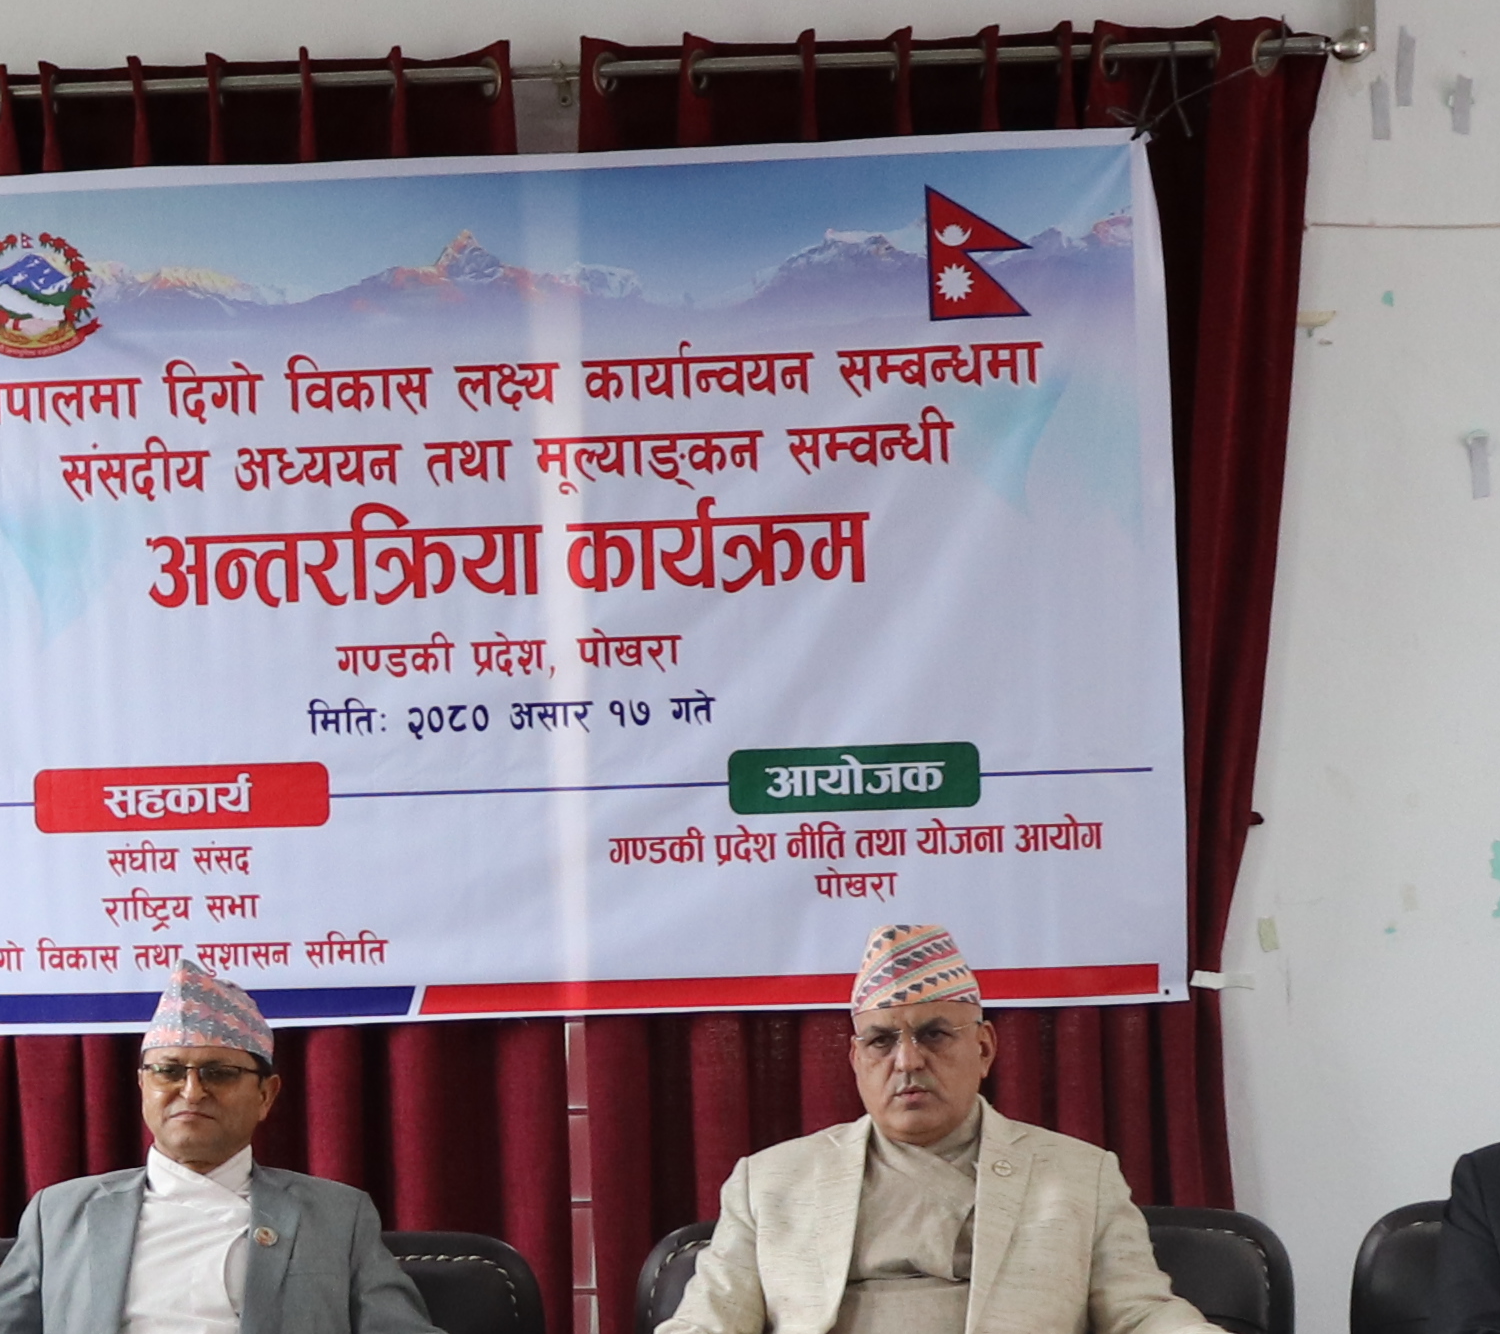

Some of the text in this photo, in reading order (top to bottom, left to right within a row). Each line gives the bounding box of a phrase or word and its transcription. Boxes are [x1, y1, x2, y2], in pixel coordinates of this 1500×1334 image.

[163, 359, 264, 424] दिगो
[285, 354, 433, 415] विकास
[455, 362, 560, 412] लक्ष्य
[582, 341, 814, 402] कार्यान्वयन
[838, 341, 1043, 397] सम्बन्धमा
[59, 436, 211, 501] संसदीय
[235, 443, 403, 492] अध्ययन
[424, 438, 512, 484] तथा
[786, 406, 955, 475] सम्वन्धी
[146, 497, 870, 608] अन्तरक्रिया कार्यक्रम
[336, 628, 682, 678] गण्डकी प्रदेश, पोखरा
[408, 703, 490, 740] २०८०
[510, 700, 594, 733] असार
[609, 698, 650, 728] १७
[670, 689, 715, 726] गते
[103, 773, 253, 820] सहकार्य
[765, 755, 945, 800] आयोजक
[107, 841, 253, 876] संघीय संसद
[609, 814, 1103, 867] गण्डकी प्रदेश नीति तथा योजना आयोग
[102, 887, 260, 931] राष्ट्रिय सभा
[815, 867, 898, 903] पोखरा
[37, 937, 121, 973] विकास
[133, 943, 184, 973] तथा
[196, 940, 291, 978] सुशासन
[304, 930, 388, 968] समिति
